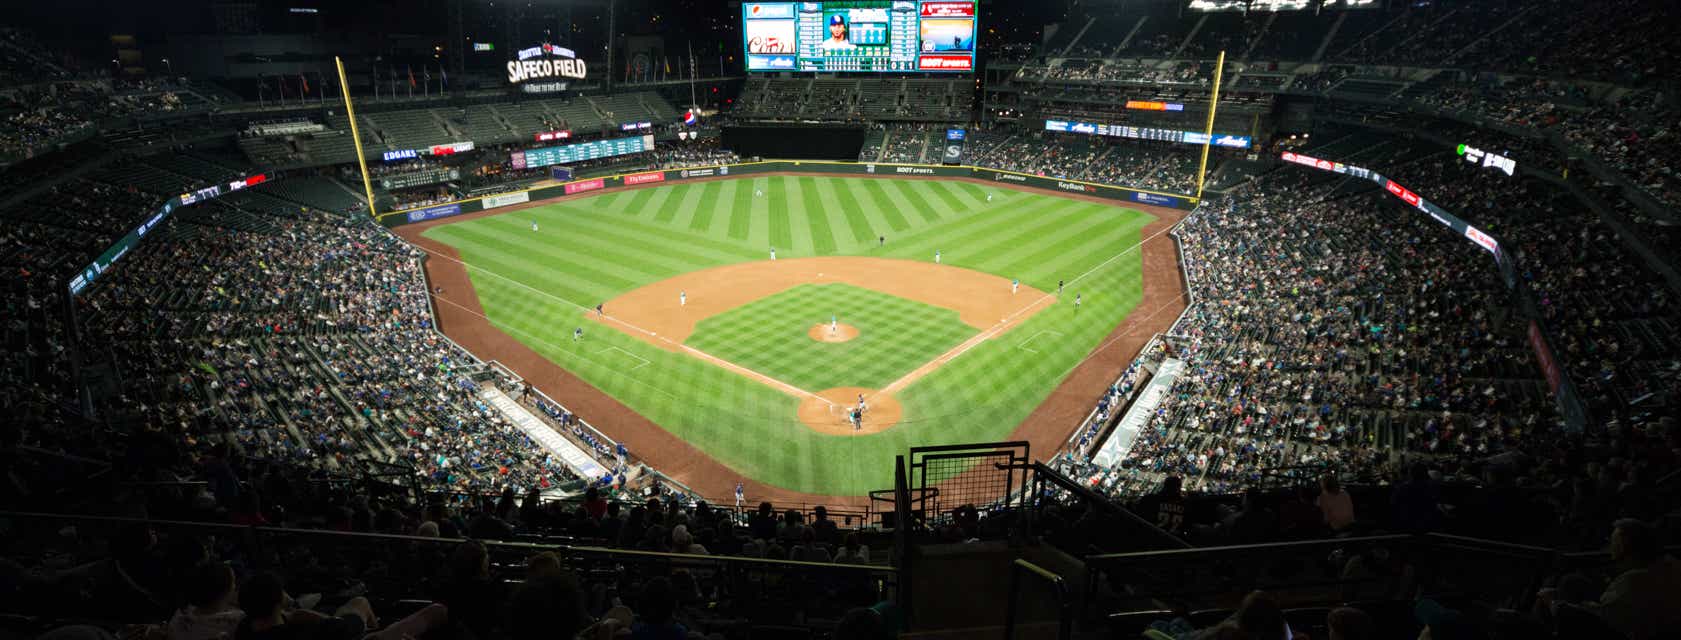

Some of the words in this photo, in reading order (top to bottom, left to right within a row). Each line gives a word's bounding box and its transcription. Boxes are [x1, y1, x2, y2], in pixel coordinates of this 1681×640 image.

[507, 60, 553, 83] SAFECO
[553, 59, 586, 79] FIELD
[384, 150, 416, 160] EDGARS
[1058, 182, 1085, 192] KeyBank
